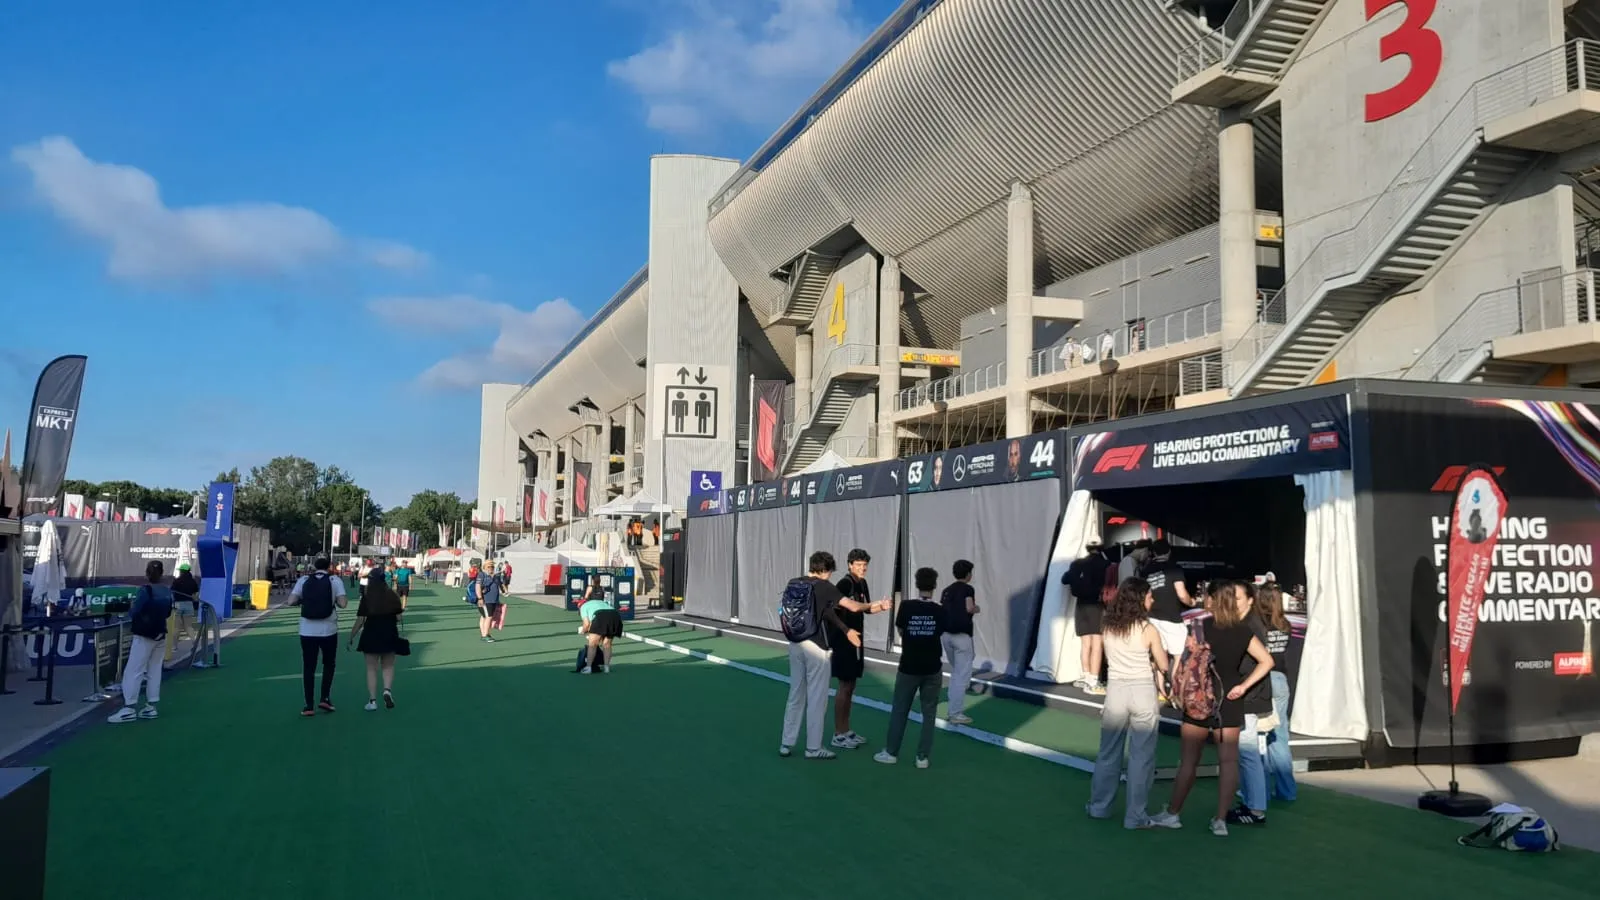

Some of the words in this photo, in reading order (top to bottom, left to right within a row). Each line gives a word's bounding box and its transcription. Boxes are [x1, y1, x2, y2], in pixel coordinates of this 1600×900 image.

[1364, 0, 1442, 122] 3
[828, 283, 847, 346] 4
[36, 416, 72, 430] MKT
[43, 408, 68, 416] EXPRESS
[1154, 436, 1201, 454] HEARING
[1202, 426, 1278, 449] PROTECTION
[1280, 425, 1290, 438] &
[1029, 439, 1054, 467] 44
[1153, 455, 1175, 468] LIVE
[1176, 450, 1210, 466] RADIO
[1212, 439, 1300, 462] COMMENTARY
[908, 461, 923, 484] 63
[738, 490, 746, 506] 63
[791, 481, 801, 498] 44
[171, 527, 198, 535] Store
[1516, 571, 1593, 594] RADIO
[1515, 660, 1543, 669] POWERED
[1544, 660, 1552, 668] BY
